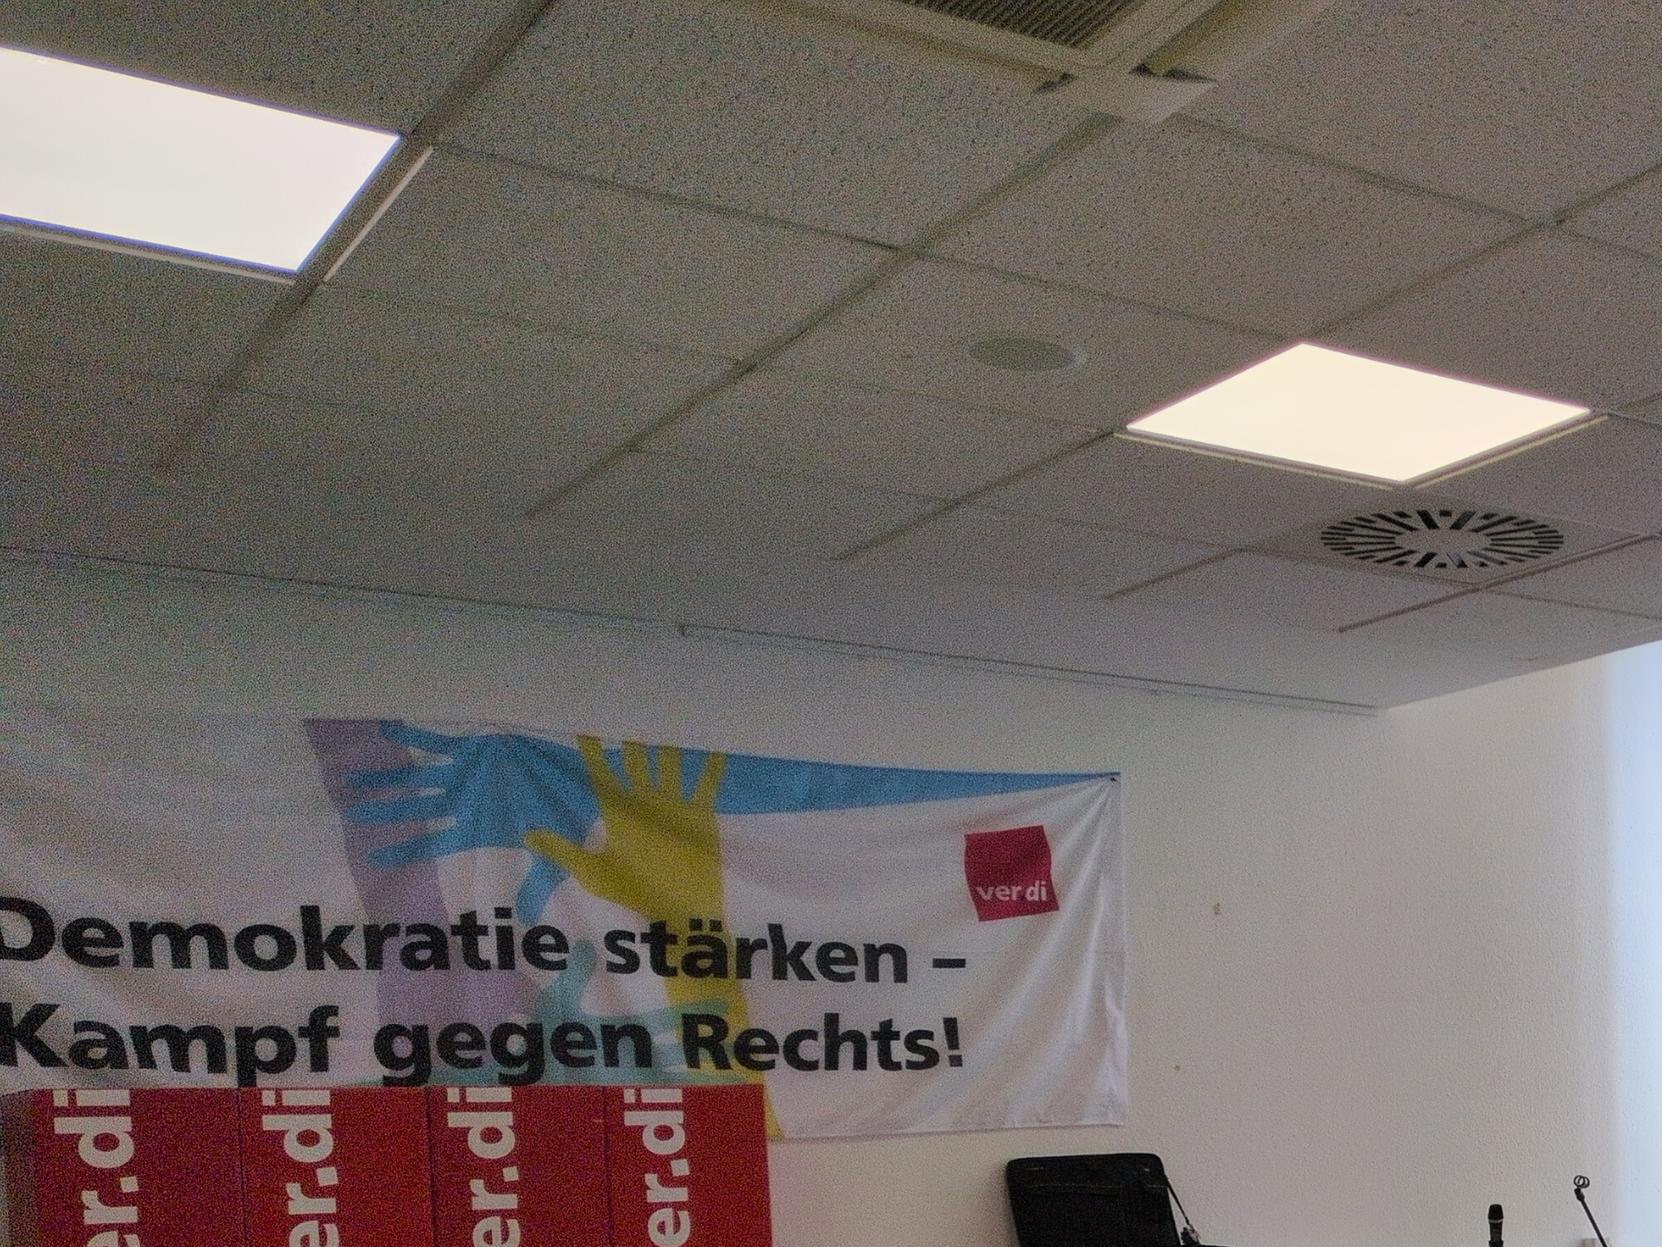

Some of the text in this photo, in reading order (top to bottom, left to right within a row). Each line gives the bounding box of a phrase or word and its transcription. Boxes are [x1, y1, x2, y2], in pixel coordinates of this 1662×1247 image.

[0, 894, 570, 974] Demokratie
[604, 919, 909, 984] stärken
[0, 1001, 964, 1088] Kampf gegen Rechts!
